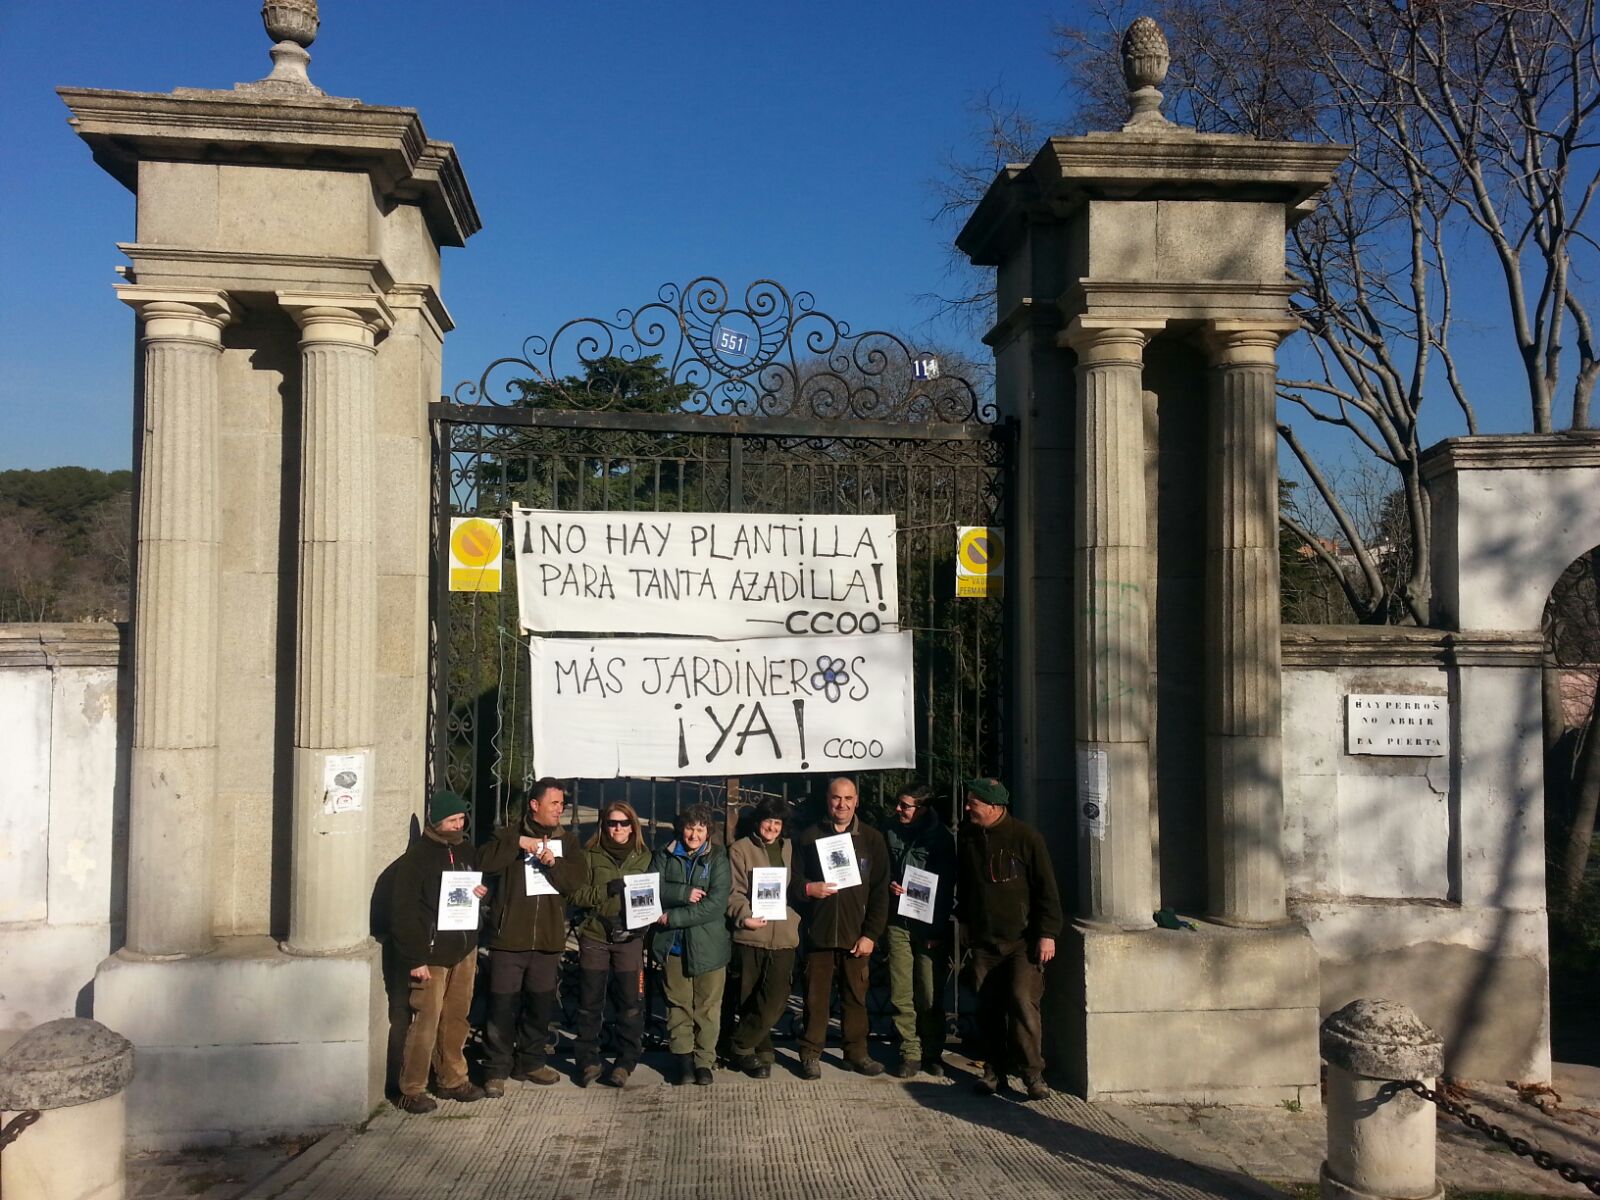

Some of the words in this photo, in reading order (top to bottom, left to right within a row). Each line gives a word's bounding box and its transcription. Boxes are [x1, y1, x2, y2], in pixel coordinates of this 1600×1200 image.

[721, 333, 743, 352] 551
[606, 521, 672, 557] HAY
[690, 517, 878, 560] PLANTILLA
[539, 563, 616, 600] PARA
[628, 566, 718, 601] TANTA
[729, 562, 887, 612] AZADILLA!
[783, 609, 882, 635] CCOO
[555, 645, 626, 699] MÁS
[673, 698, 811, 770] ¡YA!
[1362, 716, 1378, 724] NO
[1390, 717, 1434, 726] ABRIR
[823, 737, 884, 760] CCOO
[1387, 738, 1441, 746] PUERTA
